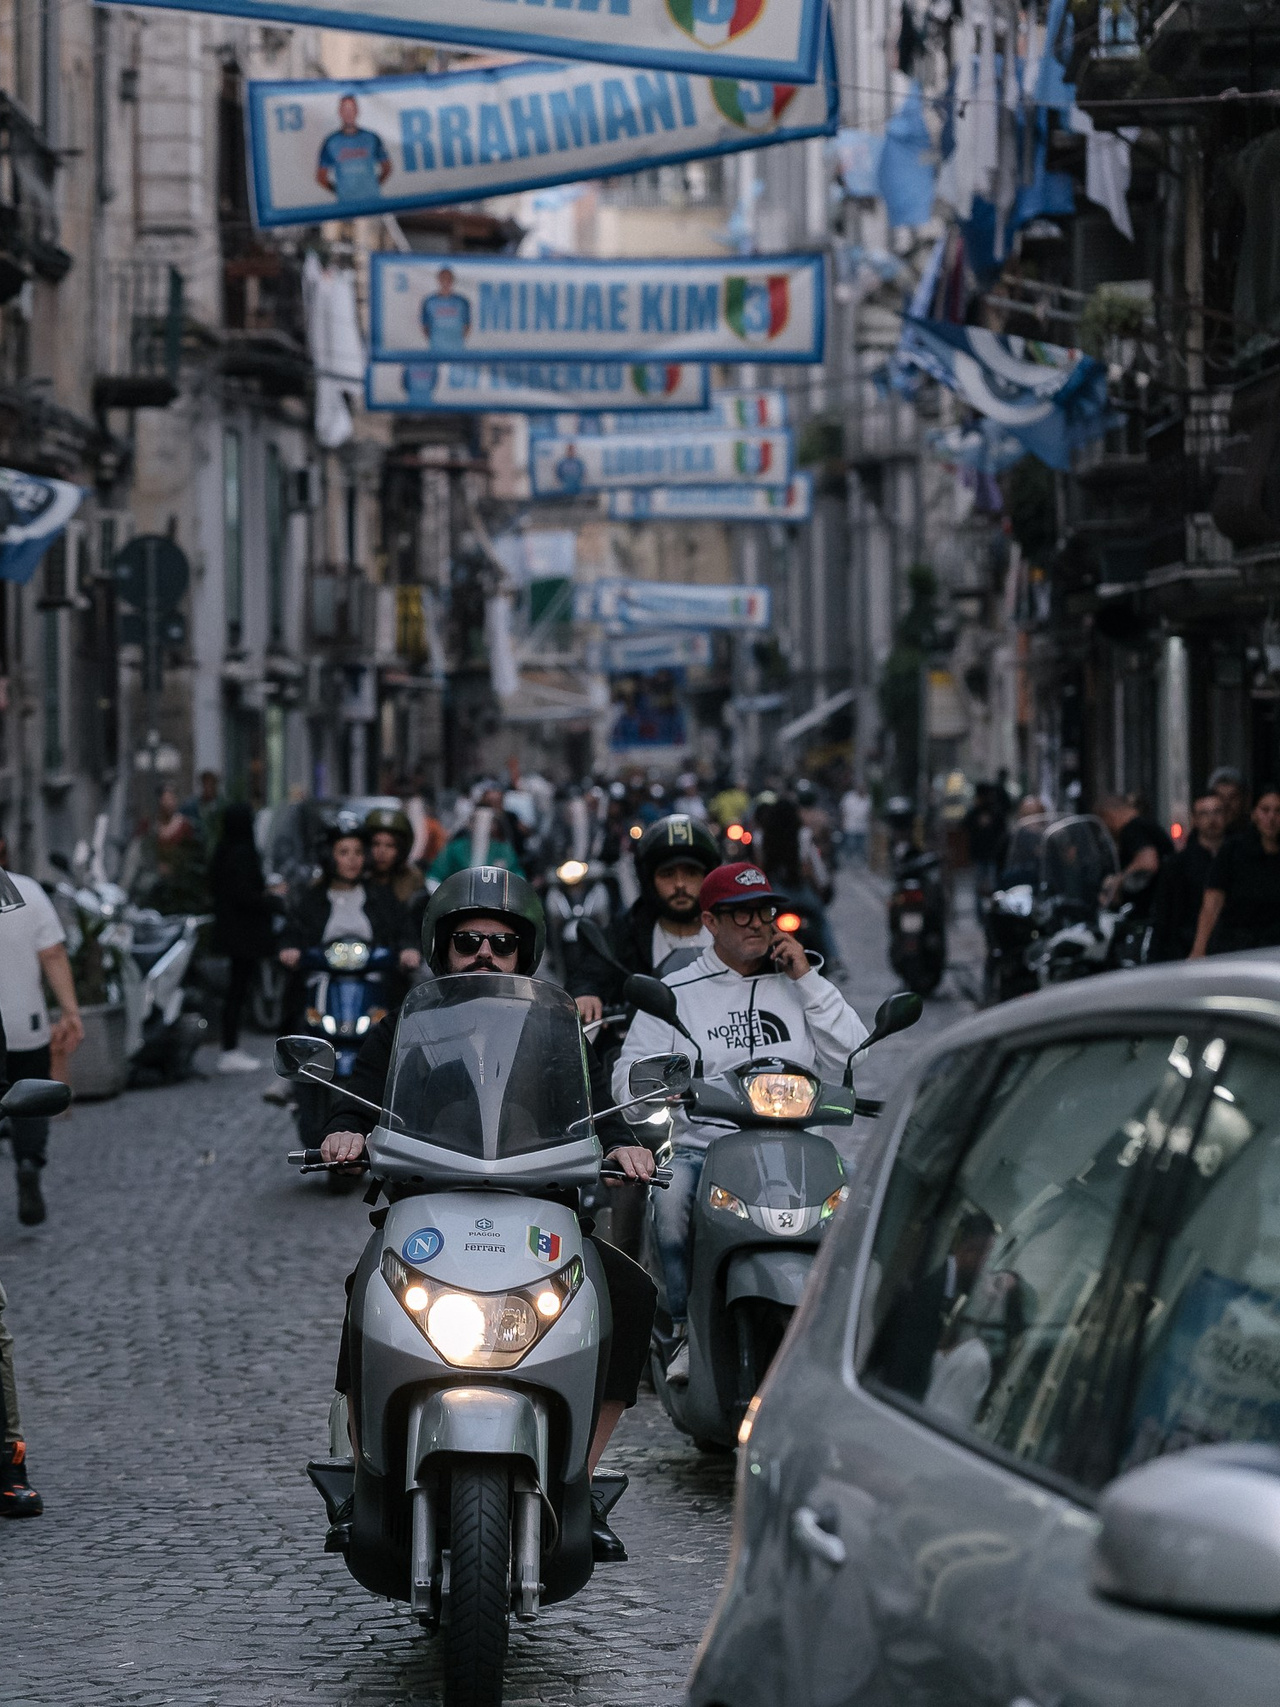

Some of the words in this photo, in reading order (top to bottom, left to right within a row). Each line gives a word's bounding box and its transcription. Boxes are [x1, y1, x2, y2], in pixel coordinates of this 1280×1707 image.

[275, 103, 305, 132] 13
[399, 71, 697, 172] RRAHMANI
[478, 281, 627, 332] MINJAE
[639, 281, 719, 332] KIM
[728, 1009, 758, 1025] THE
[707, 1022, 761, 1040] NORTH
[726, 1034, 764, 1049] FACE
[413, 1236, 432, 1255] N
[464, 1243, 506, 1253] Ferrara
